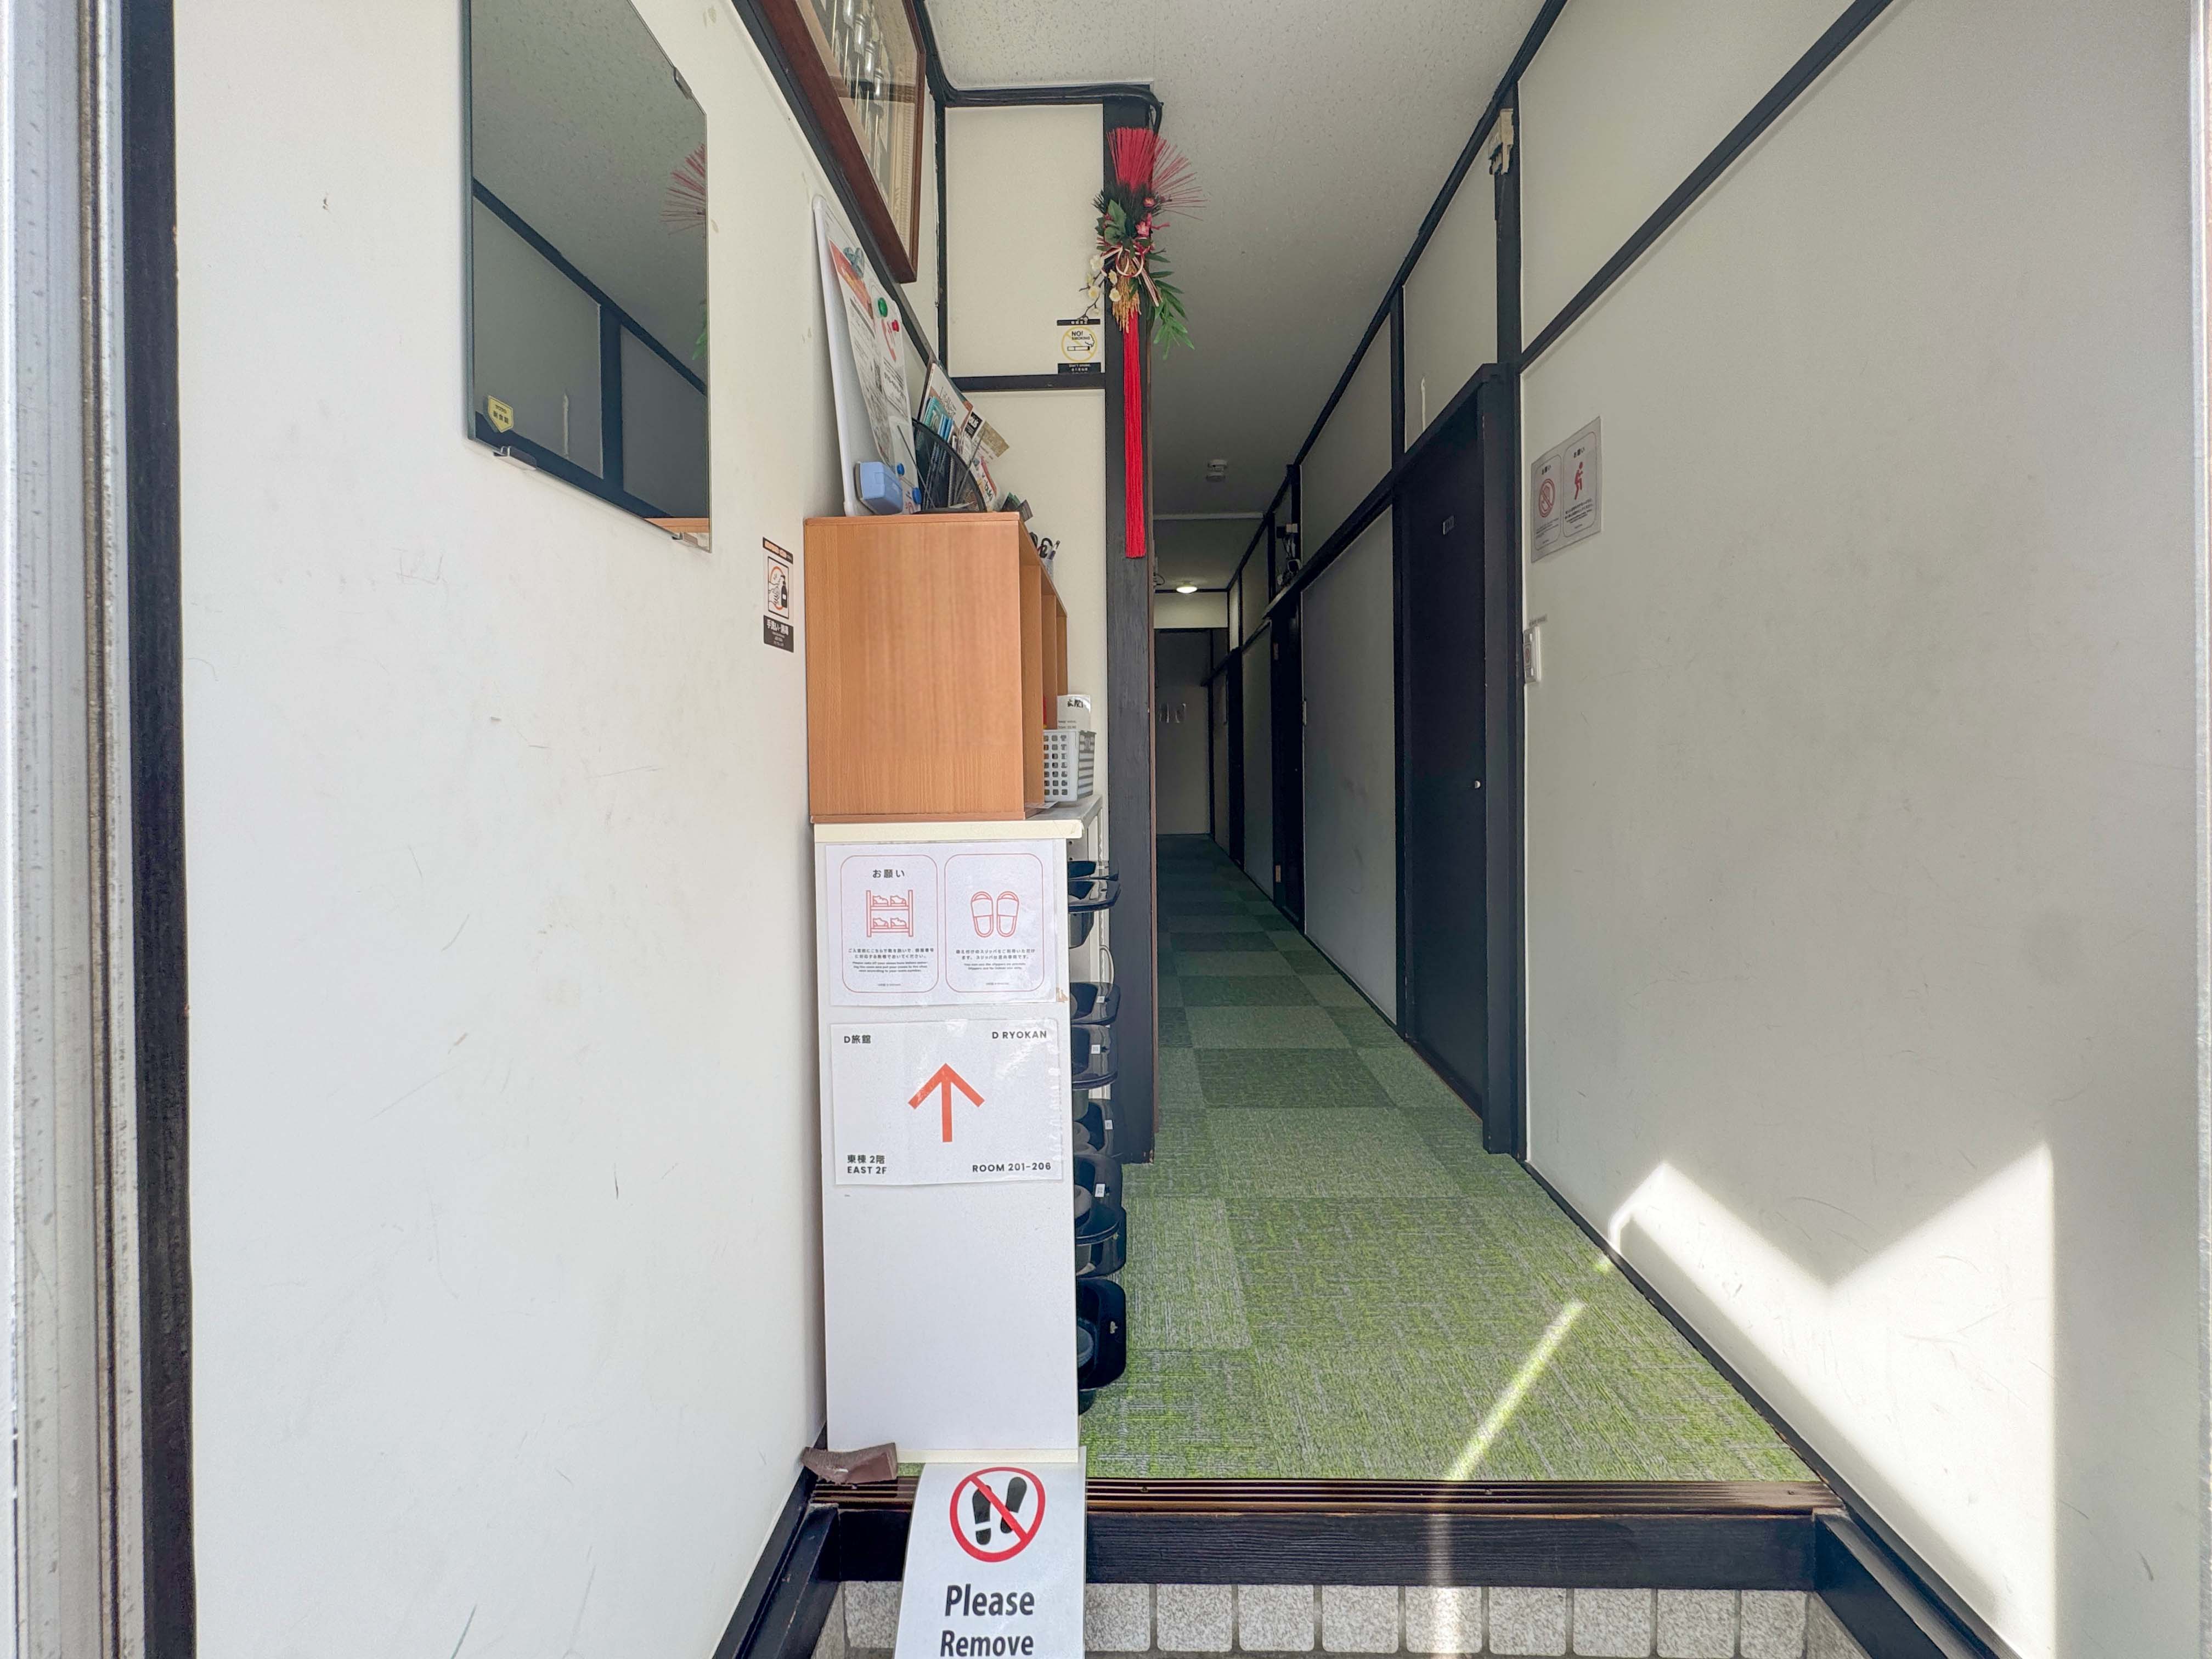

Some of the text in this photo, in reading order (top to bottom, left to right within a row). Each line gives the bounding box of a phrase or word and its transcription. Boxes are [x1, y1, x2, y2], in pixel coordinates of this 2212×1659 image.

[872, 869, 905, 878] お願い
[1002, 1030, 1047, 1039] RYOKAN
[847, 1154, 866, 1164] 東棟
[847, 1166, 887, 1175] EAST 2F
[972, 1162, 1051, 1172] ROOM 201-206
[945, 1583, 1035, 1617] Please
[940, 1630, 1034, 1657] Remove
